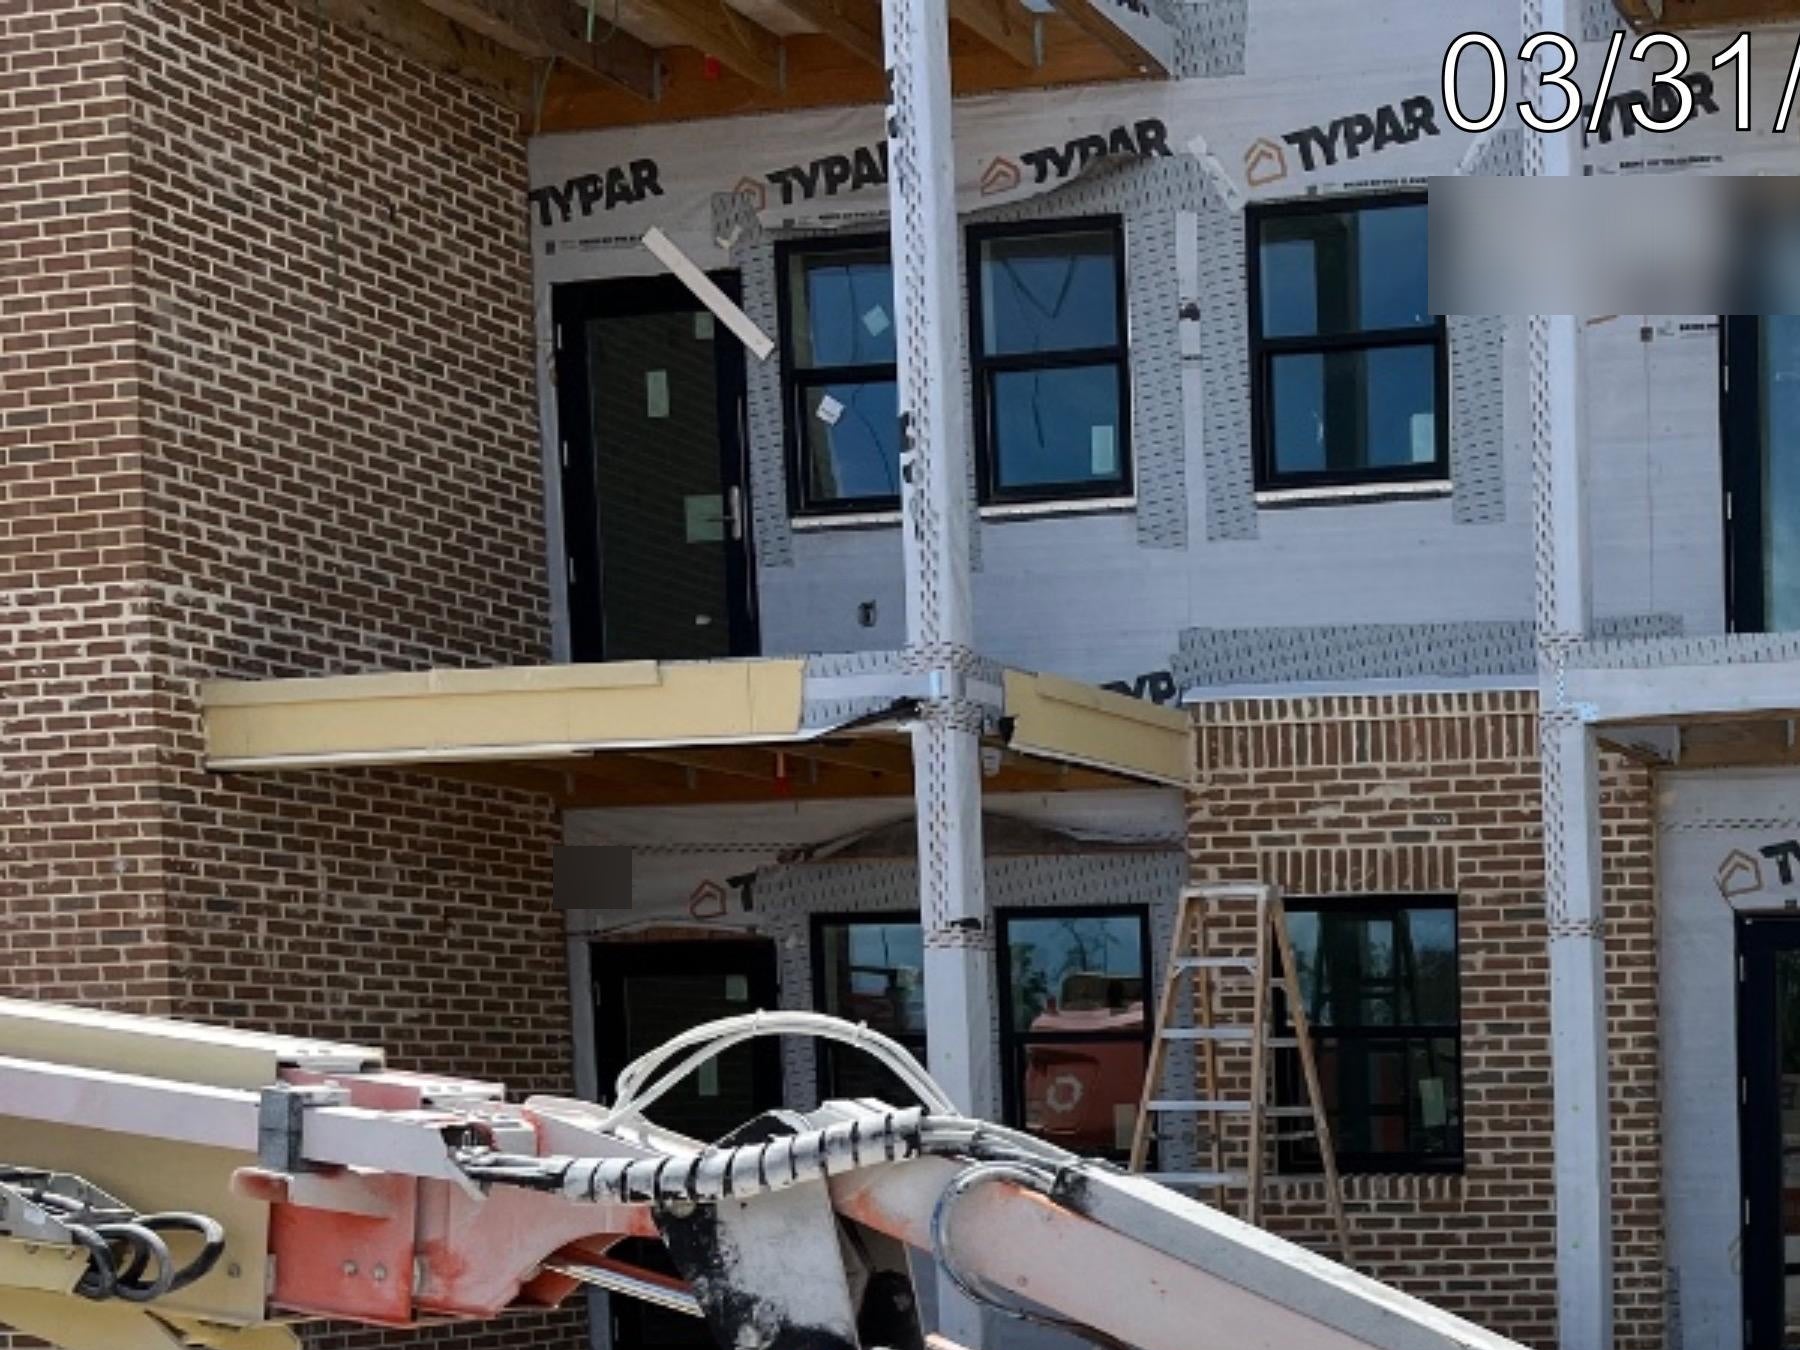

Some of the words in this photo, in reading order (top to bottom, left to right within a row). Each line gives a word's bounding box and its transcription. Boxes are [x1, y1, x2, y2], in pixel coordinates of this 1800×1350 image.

[1283, 95, 1441, 172] TYPAR
[1582, 72, 1719, 148] YPAR
[1020, 118, 1173, 183] TYPAR
[528, 158, 664, 226] TYPAR
